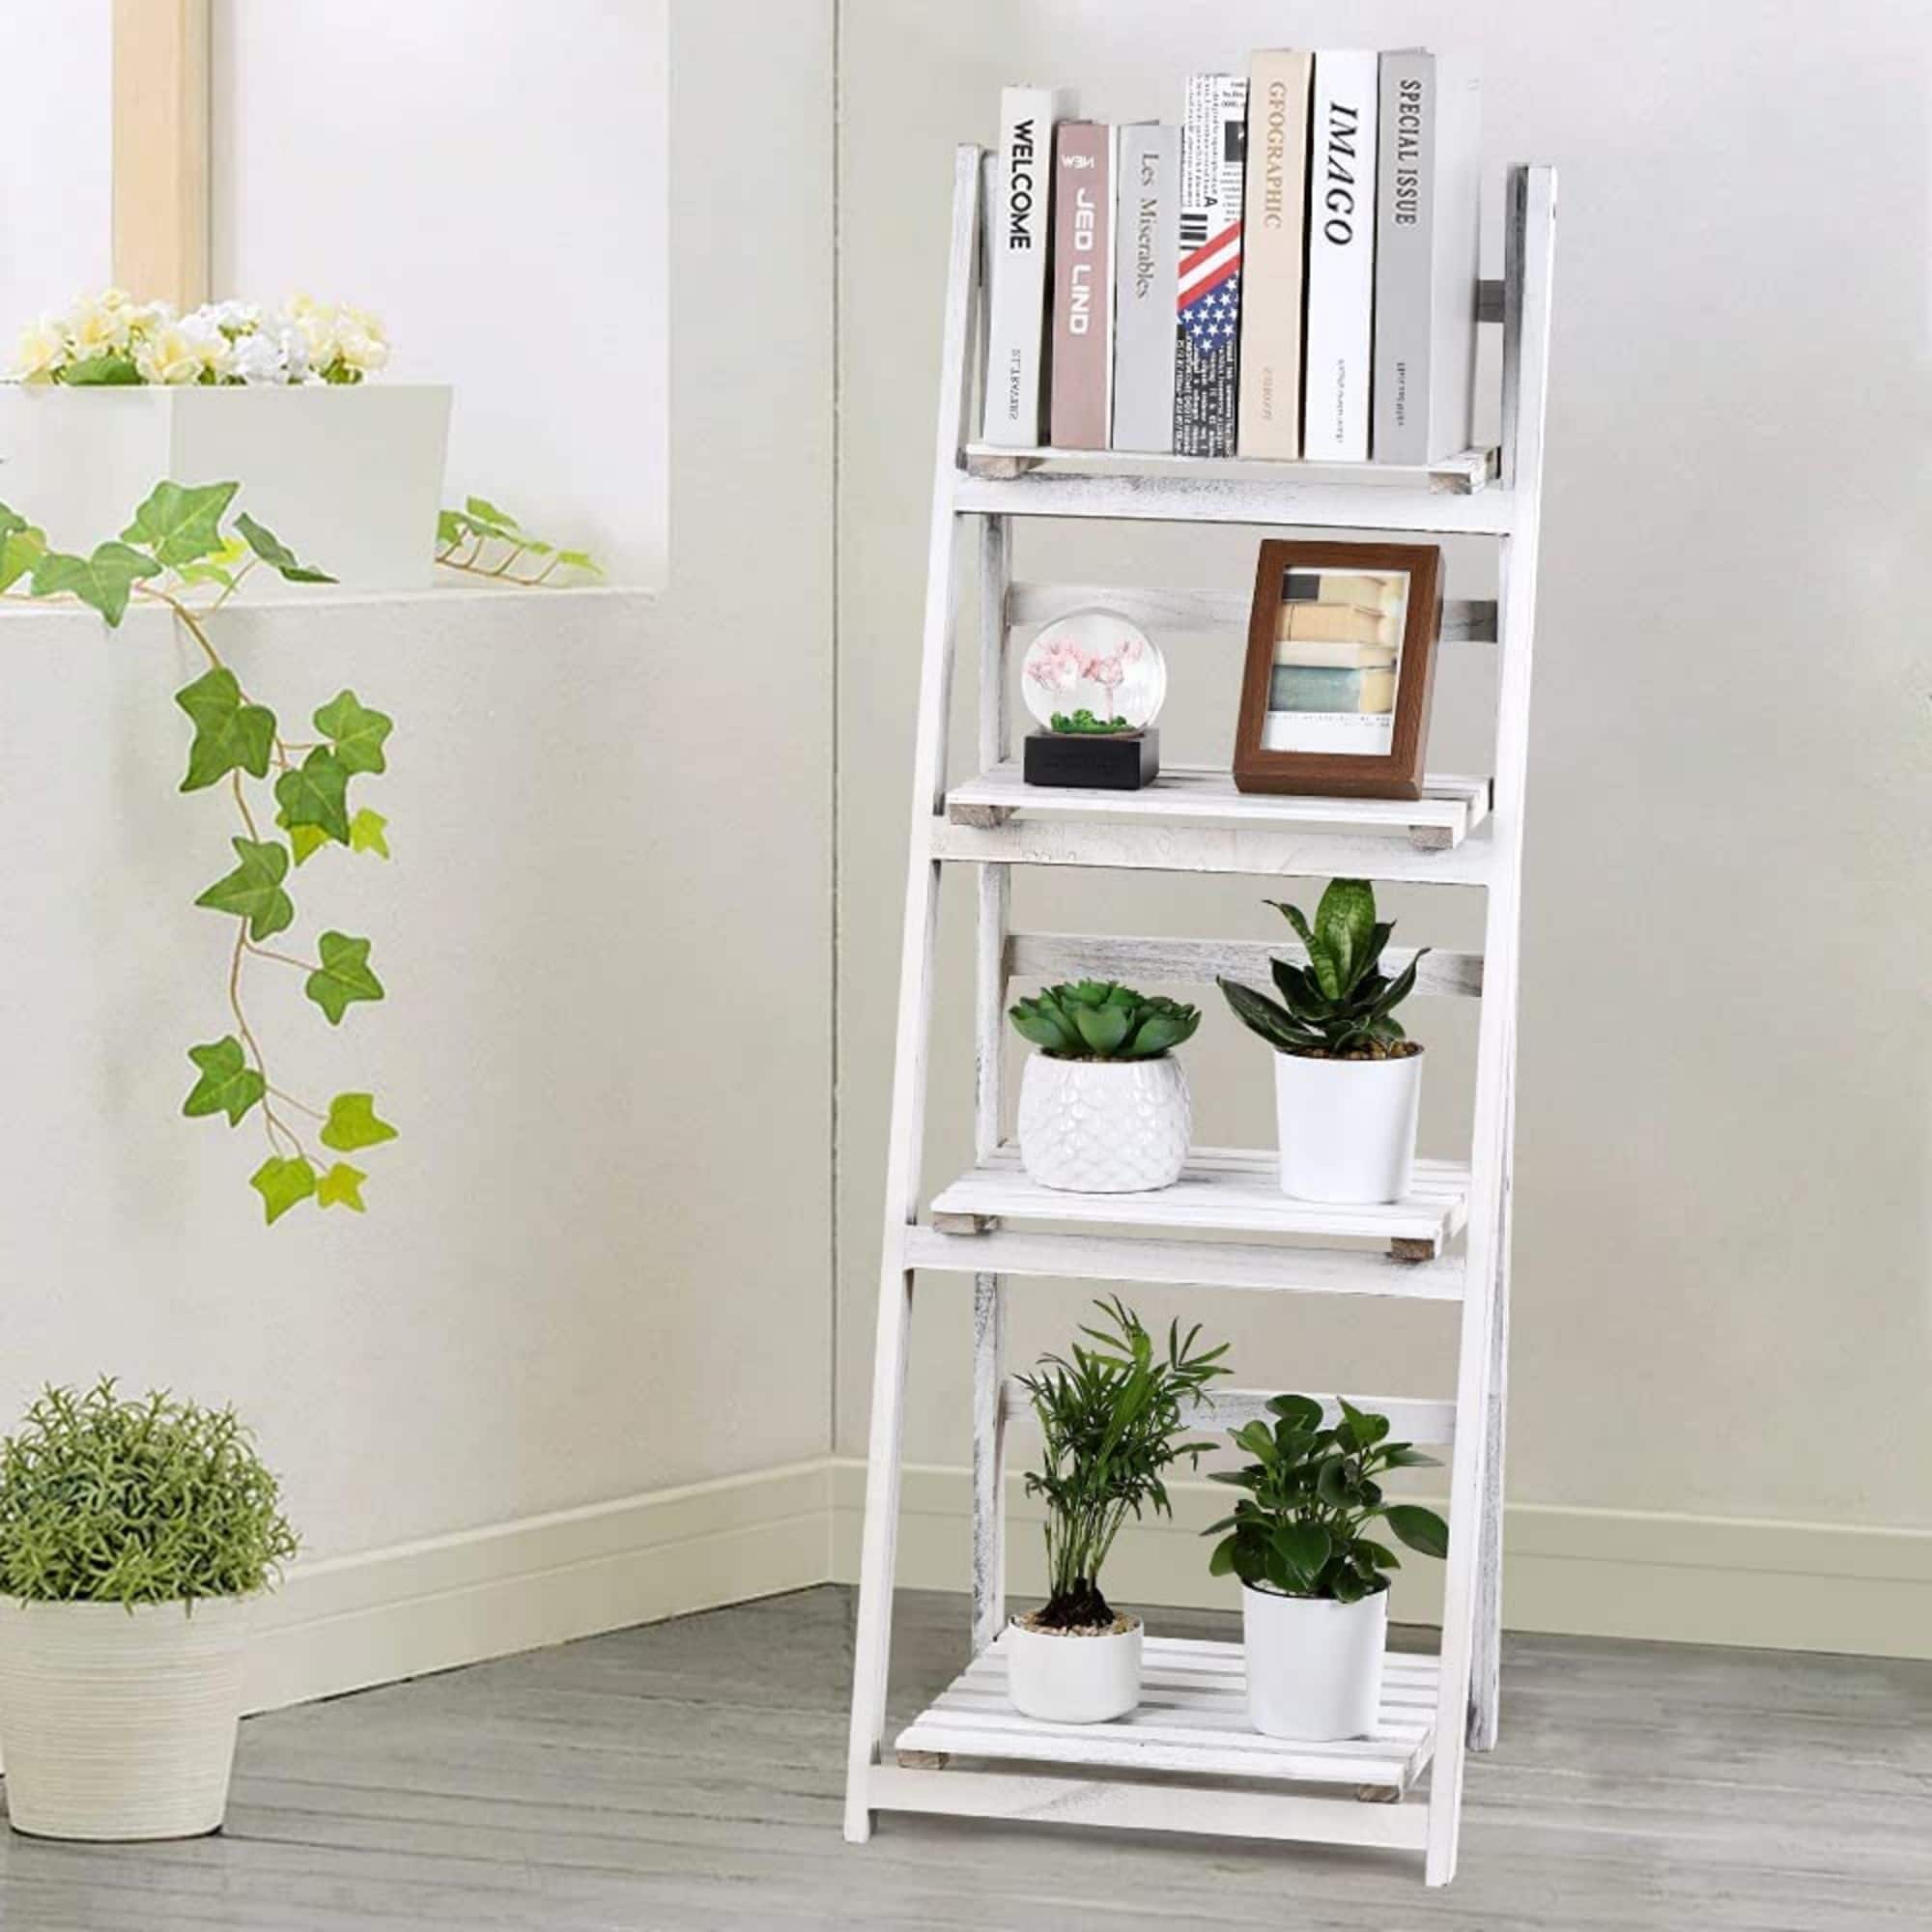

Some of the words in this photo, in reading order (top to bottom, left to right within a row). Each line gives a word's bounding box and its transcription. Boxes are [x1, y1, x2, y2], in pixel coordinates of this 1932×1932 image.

[1398, 79, 1422, 161] SPECIAL
[1009, 120, 1034, 249] WELCOME
[1141, 154, 1159, 185] Les
[1323, 100, 1358, 245] IMAGO
[1395, 169, 1418, 225] ISSUE
[1074, 187, 1095, 250] JED
[1136, 198, 1157, 298] Miserables
[1069, 265, 1092, 334] LIND
